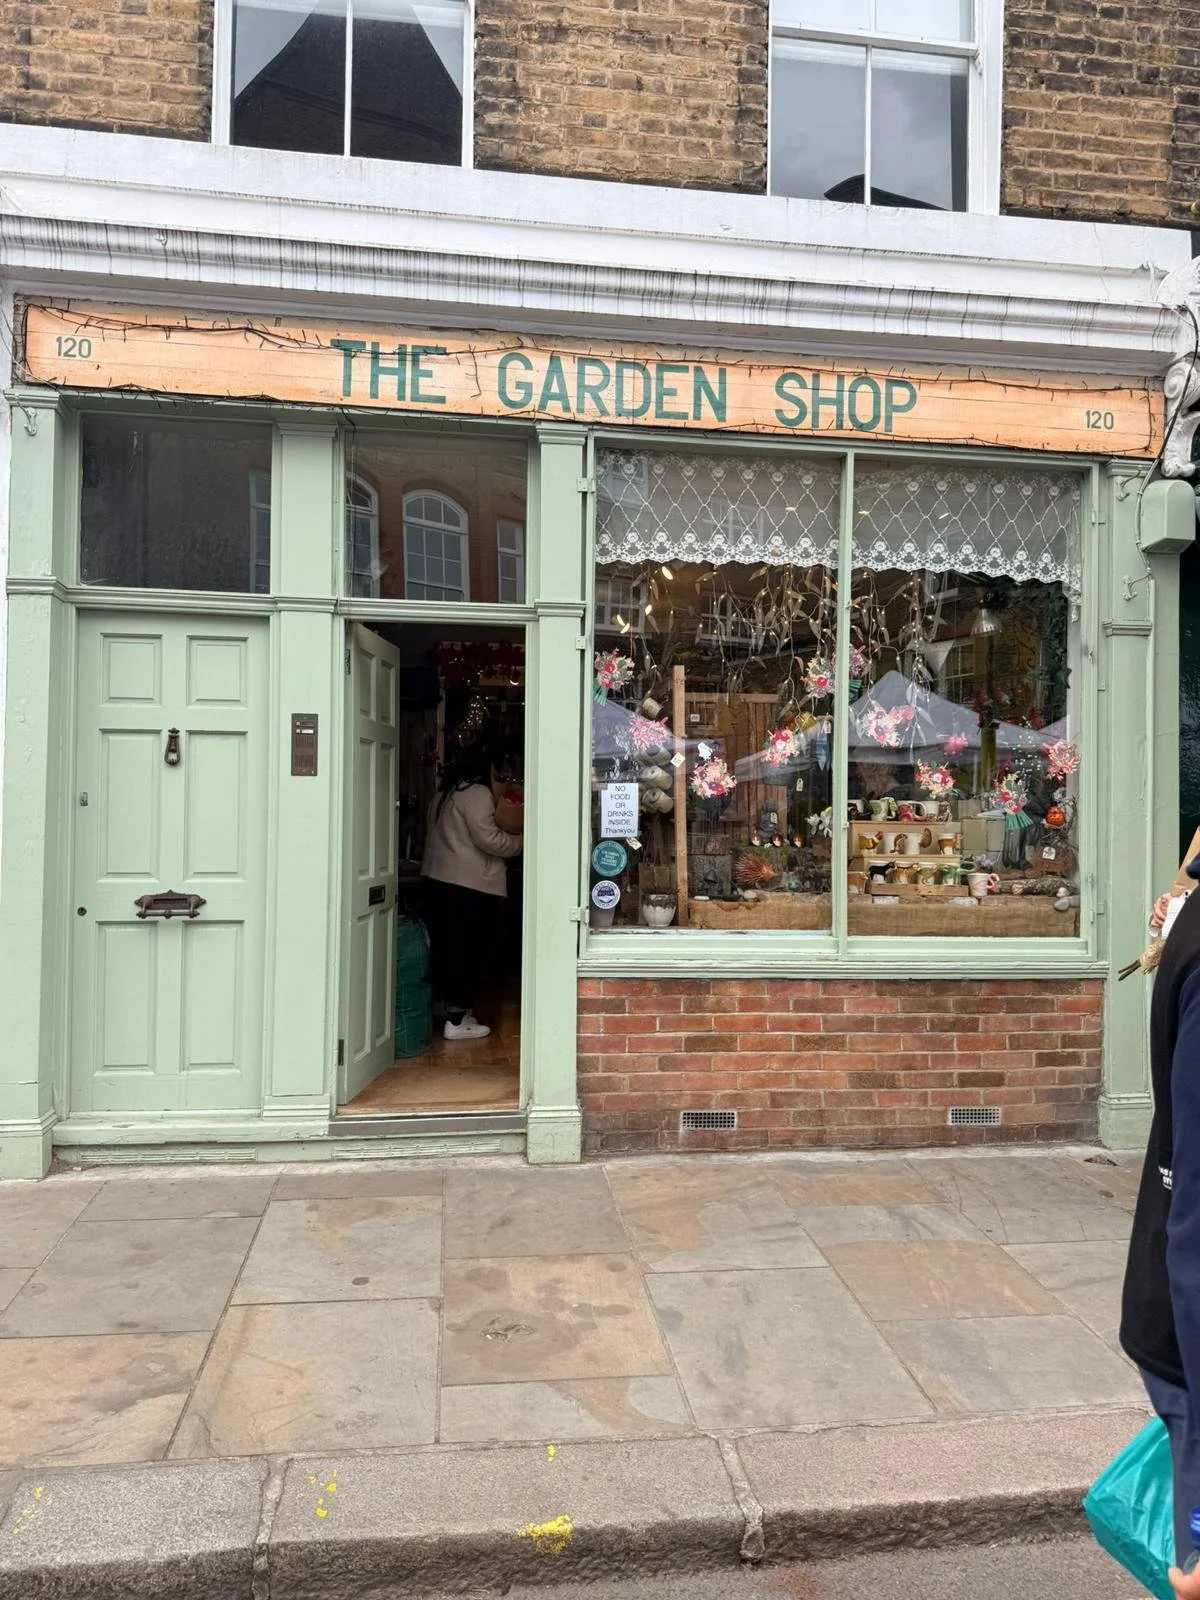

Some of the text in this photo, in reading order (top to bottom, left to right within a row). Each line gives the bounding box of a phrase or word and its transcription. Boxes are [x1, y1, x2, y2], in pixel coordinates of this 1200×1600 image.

[56, 336, 92, 359] 120
[330, 338, 918, 433] THE GARDEN SHOP
[1085, 409, 1114, 430] 120
[610, 793, 631, 801] FOOD
[607, 810, 634, 818] DRINKS
[605, 827, 636, 835] Thankyou
